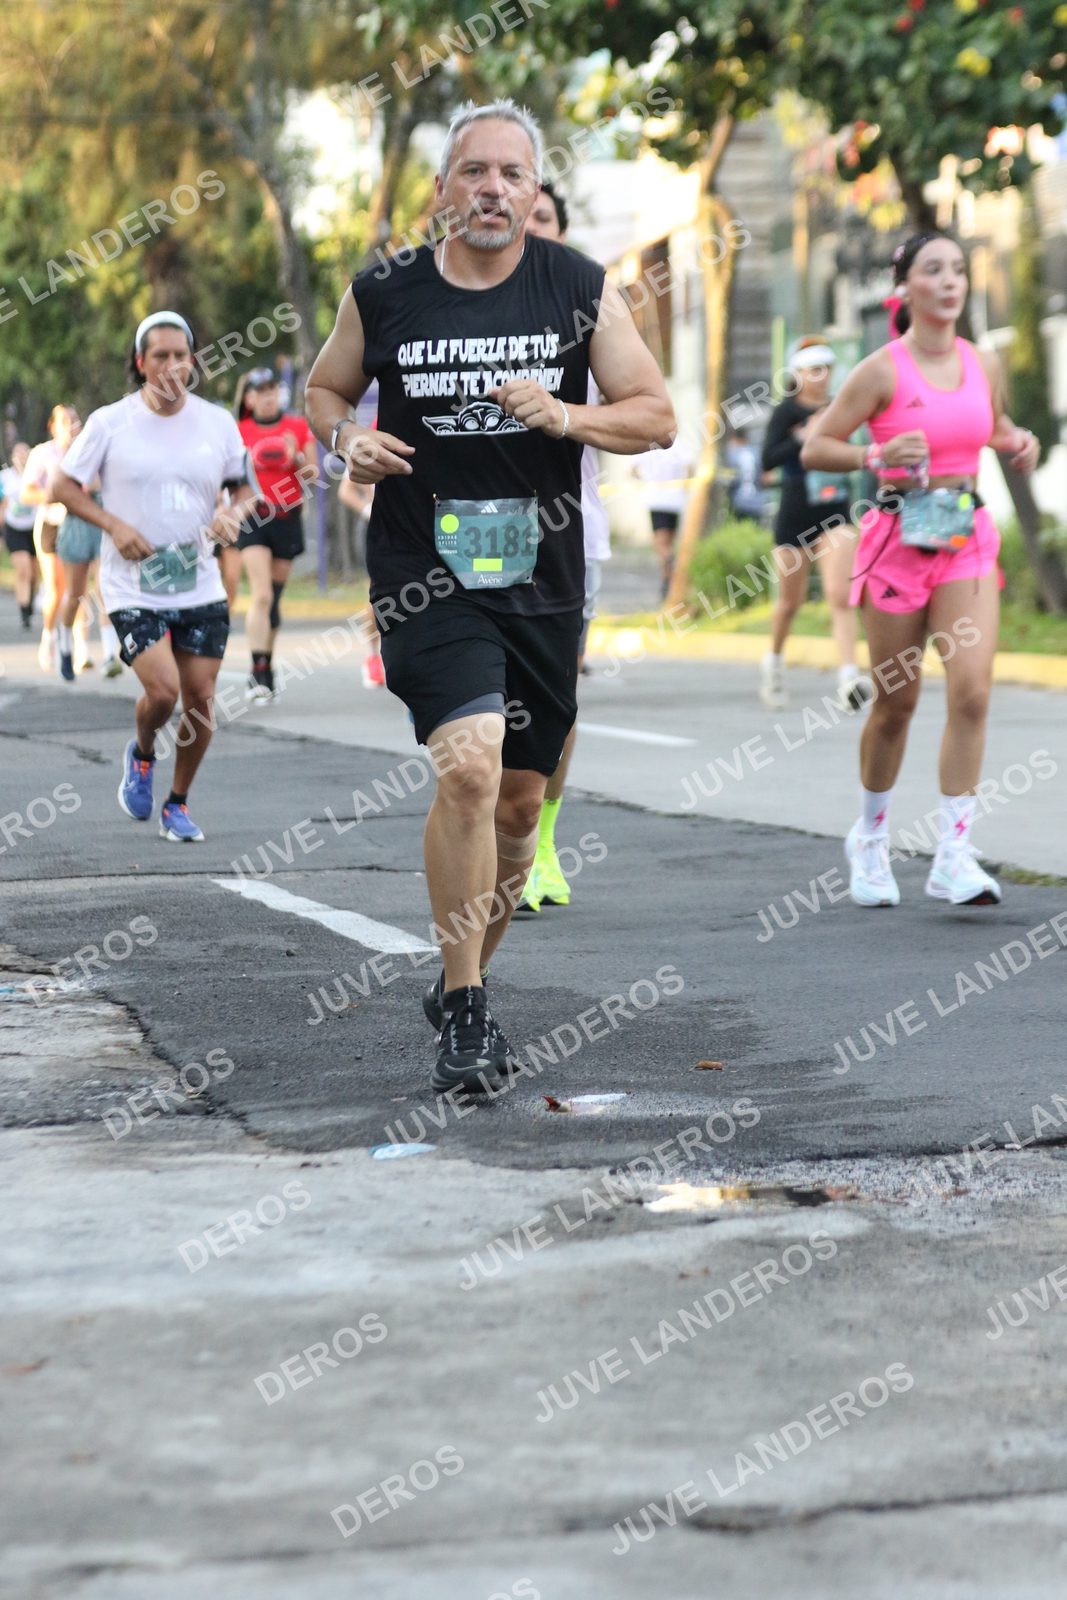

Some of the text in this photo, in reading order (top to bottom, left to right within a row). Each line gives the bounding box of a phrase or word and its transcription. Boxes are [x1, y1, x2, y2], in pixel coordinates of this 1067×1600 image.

[398, 333, 559, 366] QUE LA FUERZA DE TUS
[402, 372, 458, 398] PIERNAS
[459, 371, 480, 396] TE
